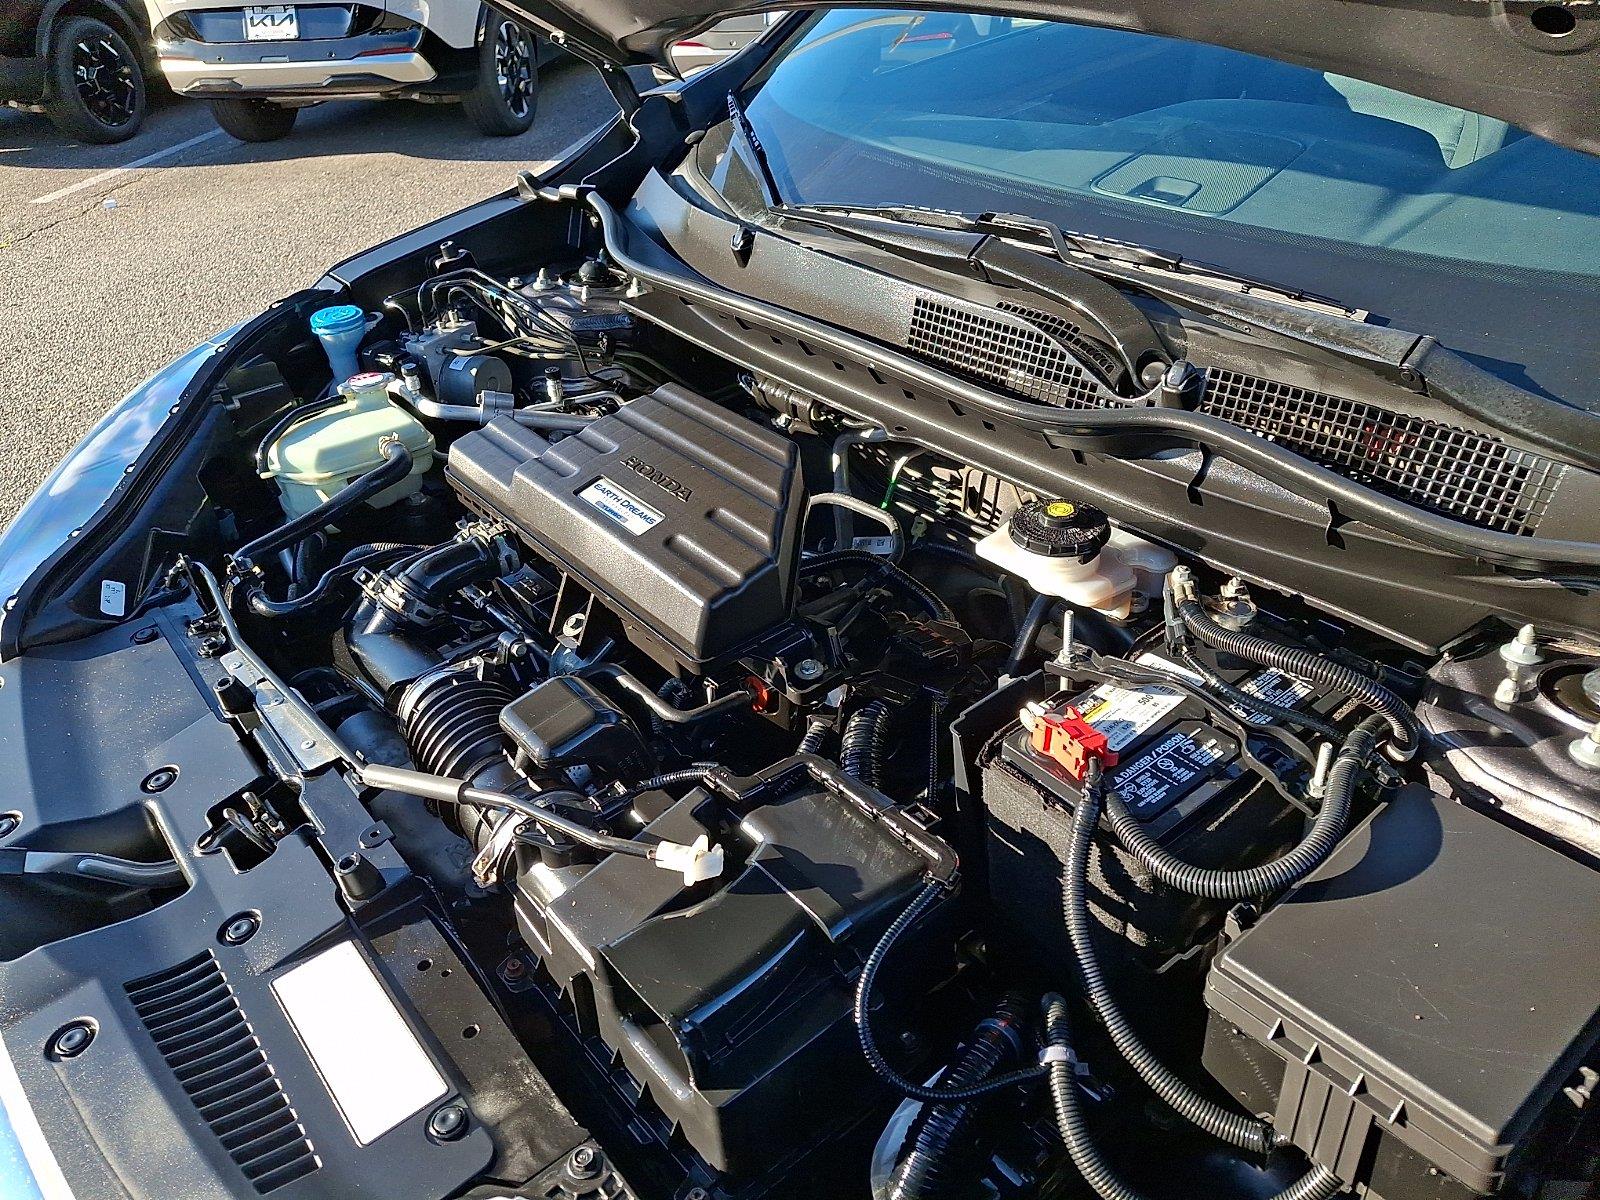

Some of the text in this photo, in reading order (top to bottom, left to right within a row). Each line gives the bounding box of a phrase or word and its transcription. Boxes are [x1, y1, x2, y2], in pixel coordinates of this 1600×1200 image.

[249, 14, 294, 27] KIA
[620, 456, 693, 503] HONDA
[594, 483, 622, 503] EARTH
[620, 499, 656, 525] DREAMS
[1120, 754, 1153, 778] DANGER
[1157, 733, 1185, 754] POISON
